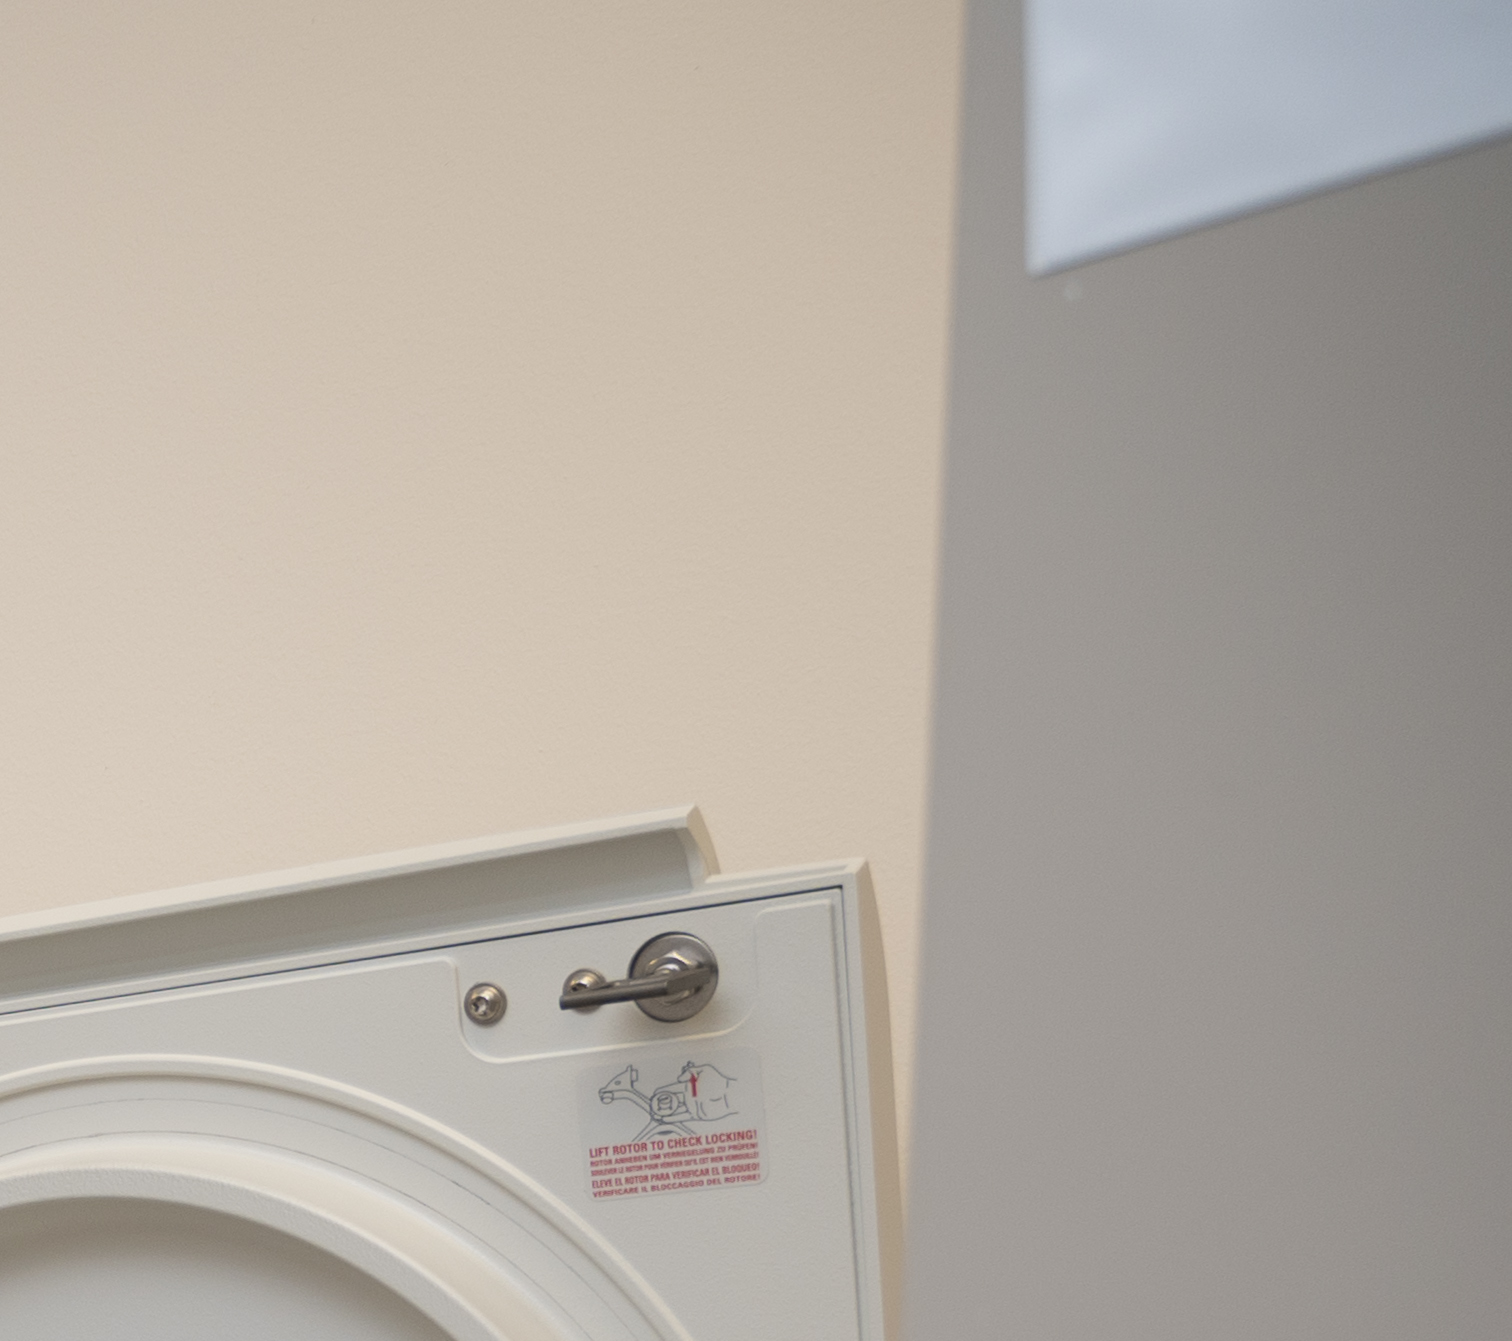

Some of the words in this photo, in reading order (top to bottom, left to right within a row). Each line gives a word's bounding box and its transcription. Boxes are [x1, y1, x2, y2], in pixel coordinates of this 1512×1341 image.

[589, 1146, 609, 1158] LIFT
[612, 1142, 648, 1155] ROTOR
[650, 1140, 664, 1151] TO
[667, 1135, 702, 1149] CHECK
[705, 1129, 757, 1145] LOCKING!
[624, 1174, 648, 1185] ROTOR
[650, 1172, 670, 1182] PARA
